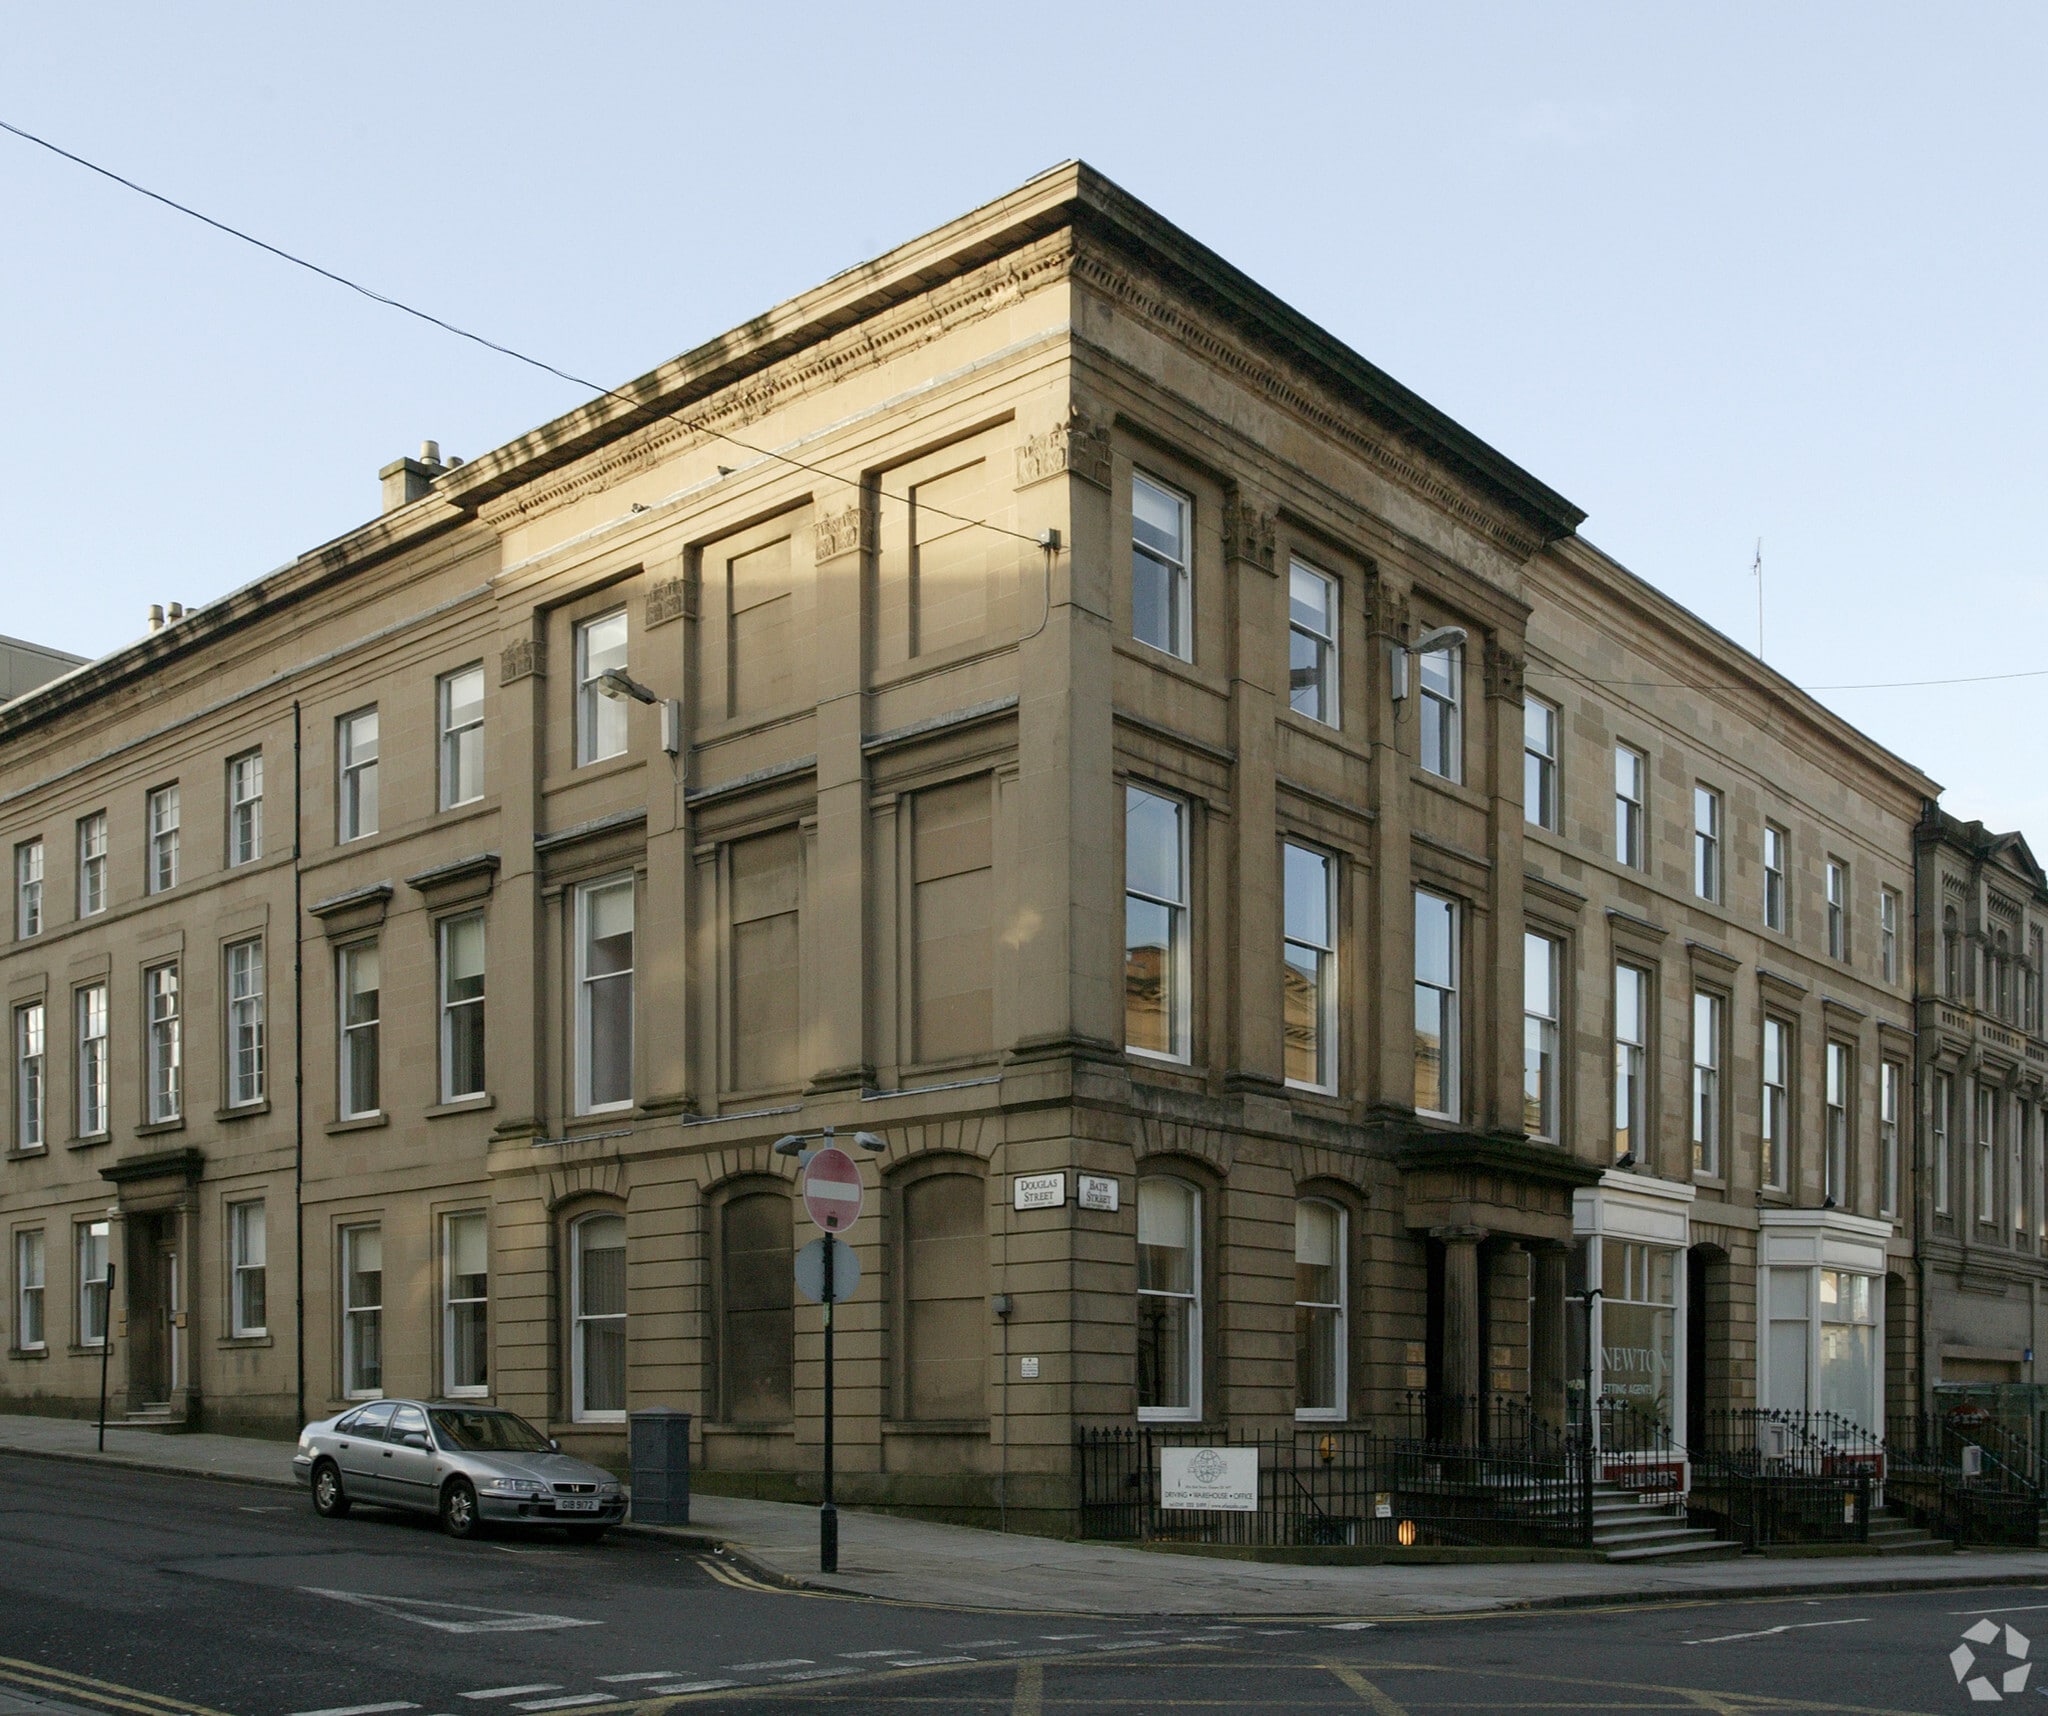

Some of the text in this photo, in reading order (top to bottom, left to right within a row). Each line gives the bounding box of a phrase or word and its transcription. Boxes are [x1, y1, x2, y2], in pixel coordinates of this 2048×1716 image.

[1021, 1179, 1057, 1191] DOUGLAS
[1089, 1179, 1108, 1192] BATH
[1024, 1191, 1054, 1202] STREET
[1086, 1192, 1112, 1204] STREET
[1601, 1347, 1669, 1373] NEWTON
[1629, 1384, 1653, 1395] AGENTS
[1234, 1492, 1253, 1500] OFFICE
